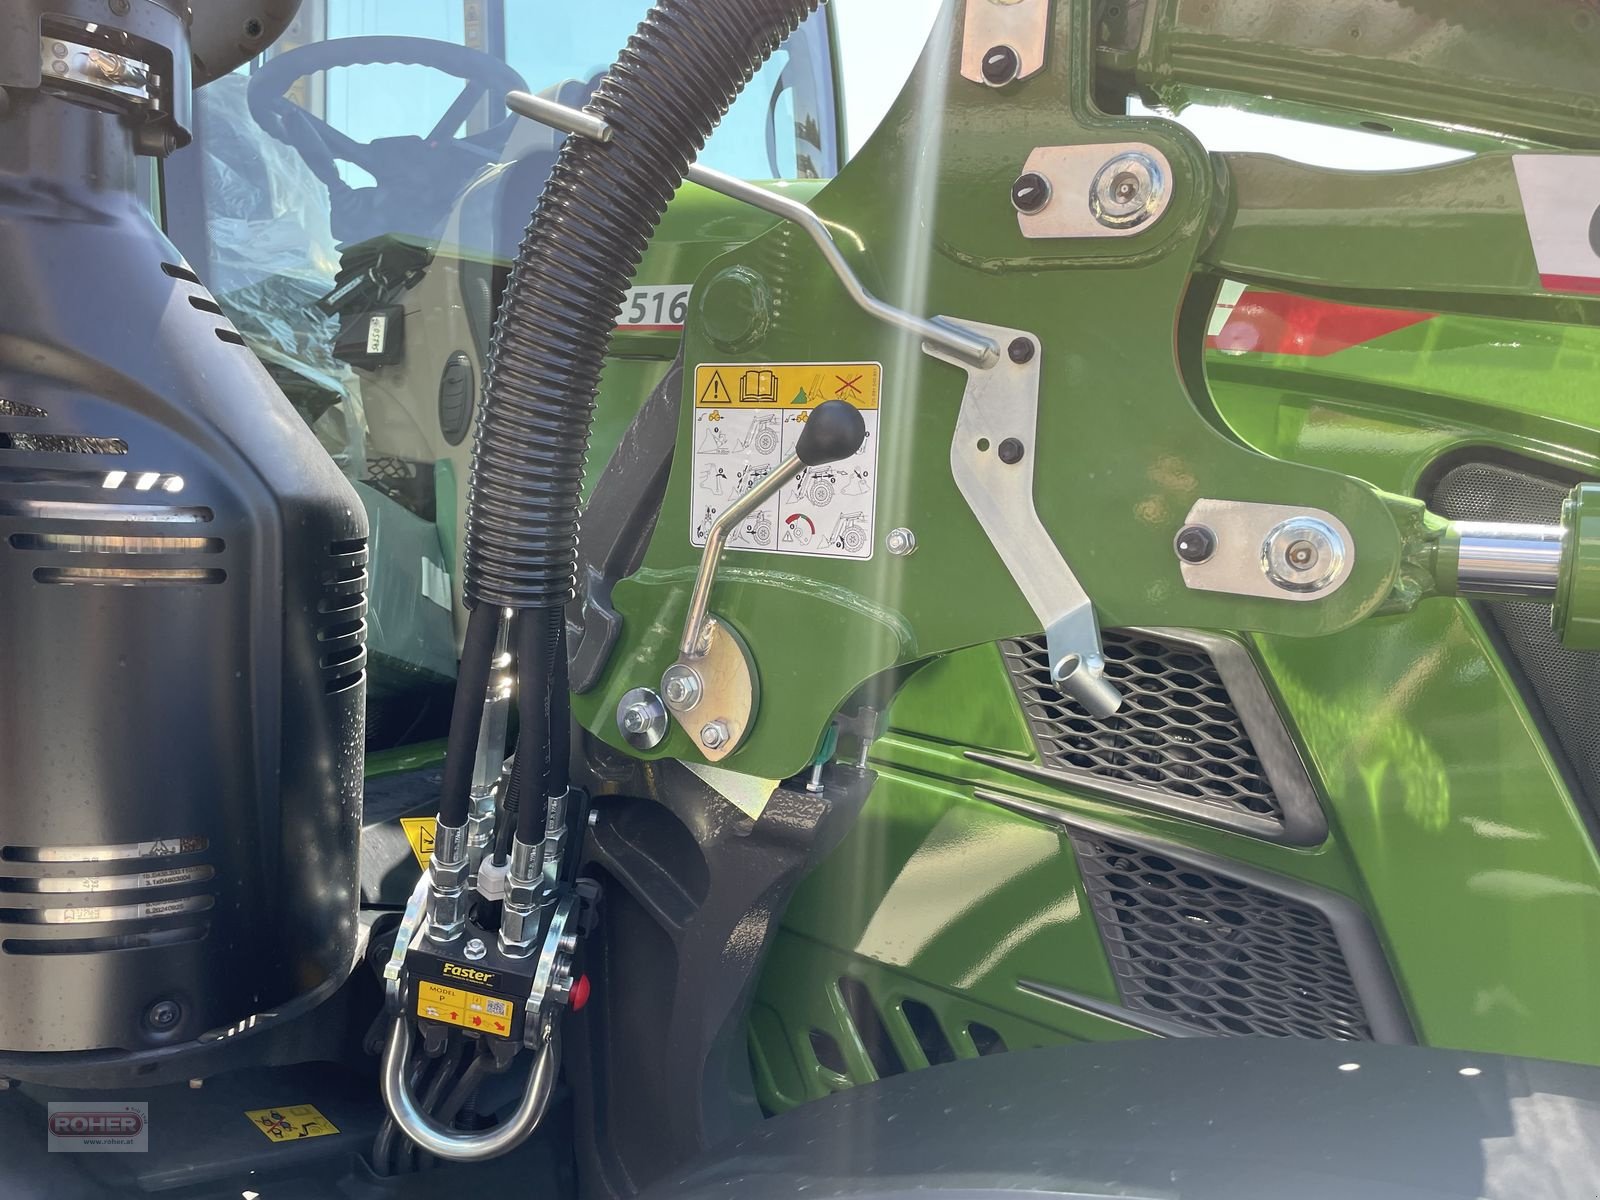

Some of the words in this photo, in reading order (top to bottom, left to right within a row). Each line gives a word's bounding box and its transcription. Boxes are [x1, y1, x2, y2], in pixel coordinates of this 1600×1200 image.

[628, 291, 688, 324] 516
[443, 963, 492, 981] Faster
[429, 986, 456, 997] MODEL
